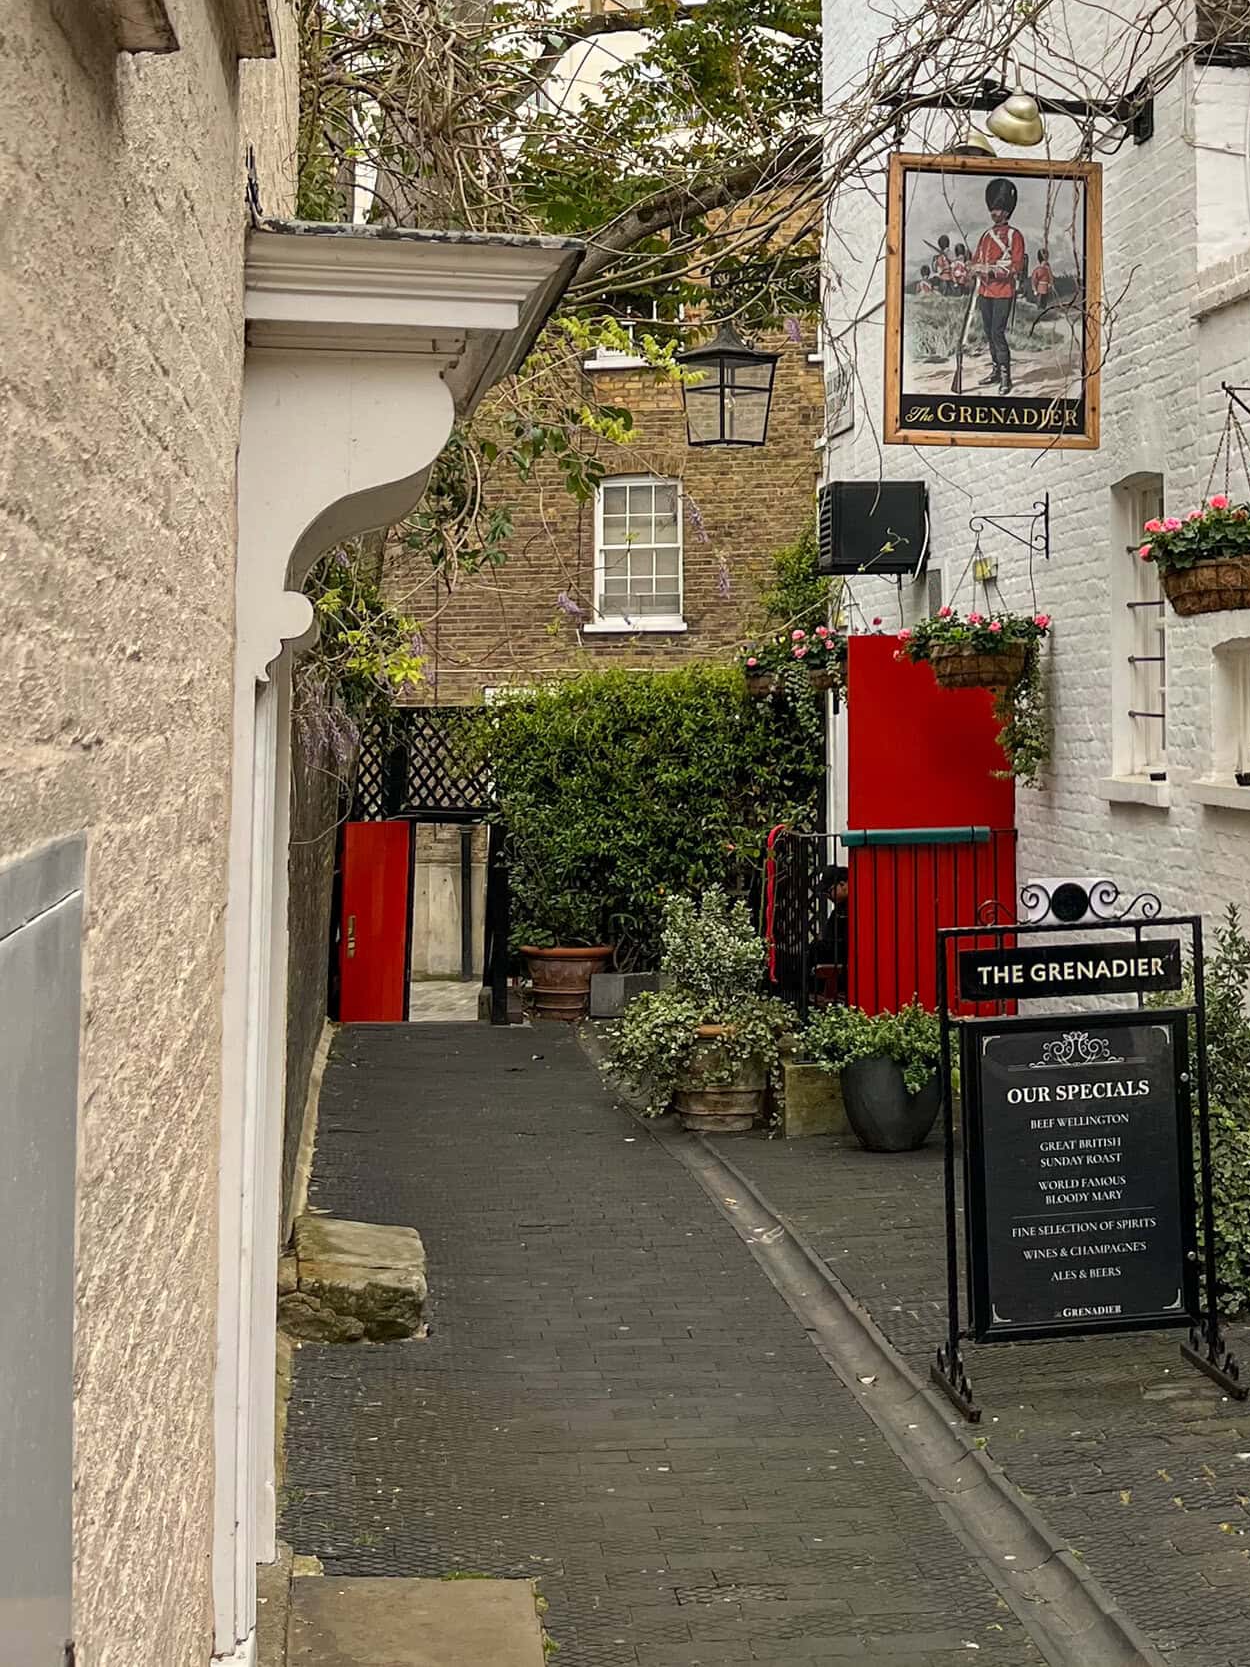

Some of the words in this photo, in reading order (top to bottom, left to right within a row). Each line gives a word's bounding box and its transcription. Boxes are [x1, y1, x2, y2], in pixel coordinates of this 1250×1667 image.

[904, 405, 935, 423] The
[937, 402, 1078, 427] GRENADIER
[977, 964, 1024, 985] THE
[1030, 957, 1165, 982] GRENADIER
[1007, 1086, 1051, 1104] OUR
[1055, 1079, 1150, 1101] SPECIALS
[1030, 1118, 1055, 1130] BEEF
[1056, 1113, 1129, 1127] WELLINGTON
[1040, 1140, 1077, 1152] GREAT
[1079, 1137, 1121, 1149] BRITISH
[1040, 1155, 1085, 1168] SUNDAY
[1086, 1152, 1122, 1165] ROAST
[1038, 1178, 1079, 1191] WORLD
[1081, 1175, 1126, 1188] FAMOUS
[1045, 1192, 1090, 1205] BLOODY
[1091, 1190, 1123, 1201] MARY
[1012, 1227, 1036, 1238] FINE
[1038, 1222, 1098, 1235] SELECTION
[1099, 1221, 1115, 1231] OF
[1116, 1217, 1157, 1230] SPIRITS
[1023, 1248, 1058, 1260] WINES
[1059, 1247, 1068, 1257] &
[1070, 1241, 1147, 1256] CHAMPAGNES
[1051, 1270, 1078, 1282] ALES
[1078, 1269, 1087, 1279] &
[1089, 1266, 1122, 1279] BEERS
[1062, 1305, 1122, 1318] GRENADIER
